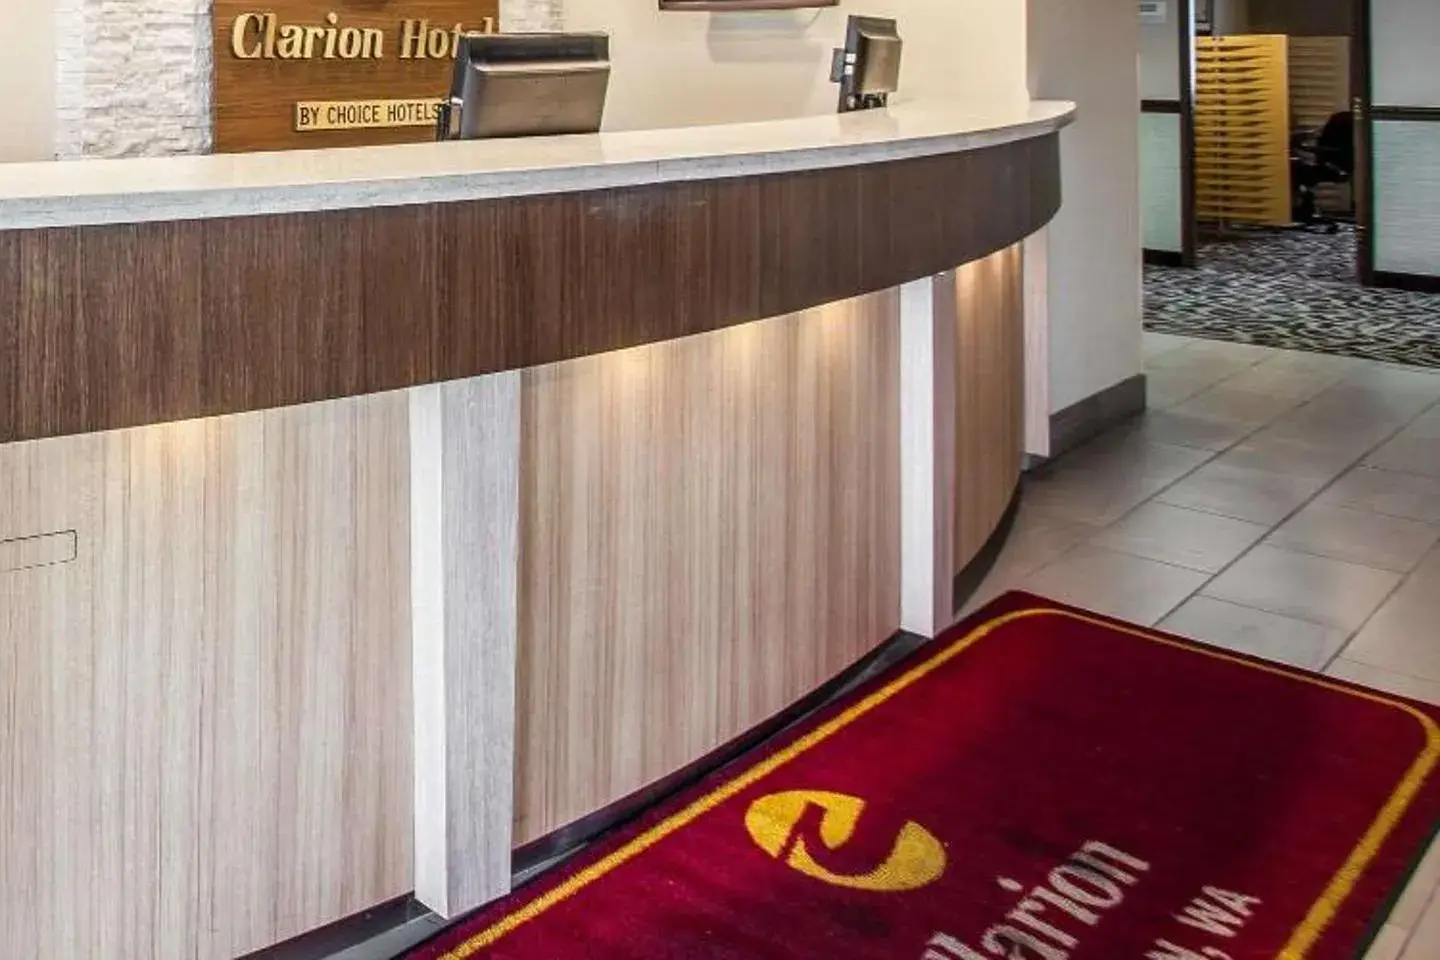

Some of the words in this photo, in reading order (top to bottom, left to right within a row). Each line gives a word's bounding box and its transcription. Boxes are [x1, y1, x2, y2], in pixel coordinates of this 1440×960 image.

[232, 12, 384, 59] Clarion
[399, 16, 494, 59] Hot
[300, 107, 320, 126] BY
[327, 104, 381, 124] CHOICE
[387, 102, 440, 122] HOTELS
